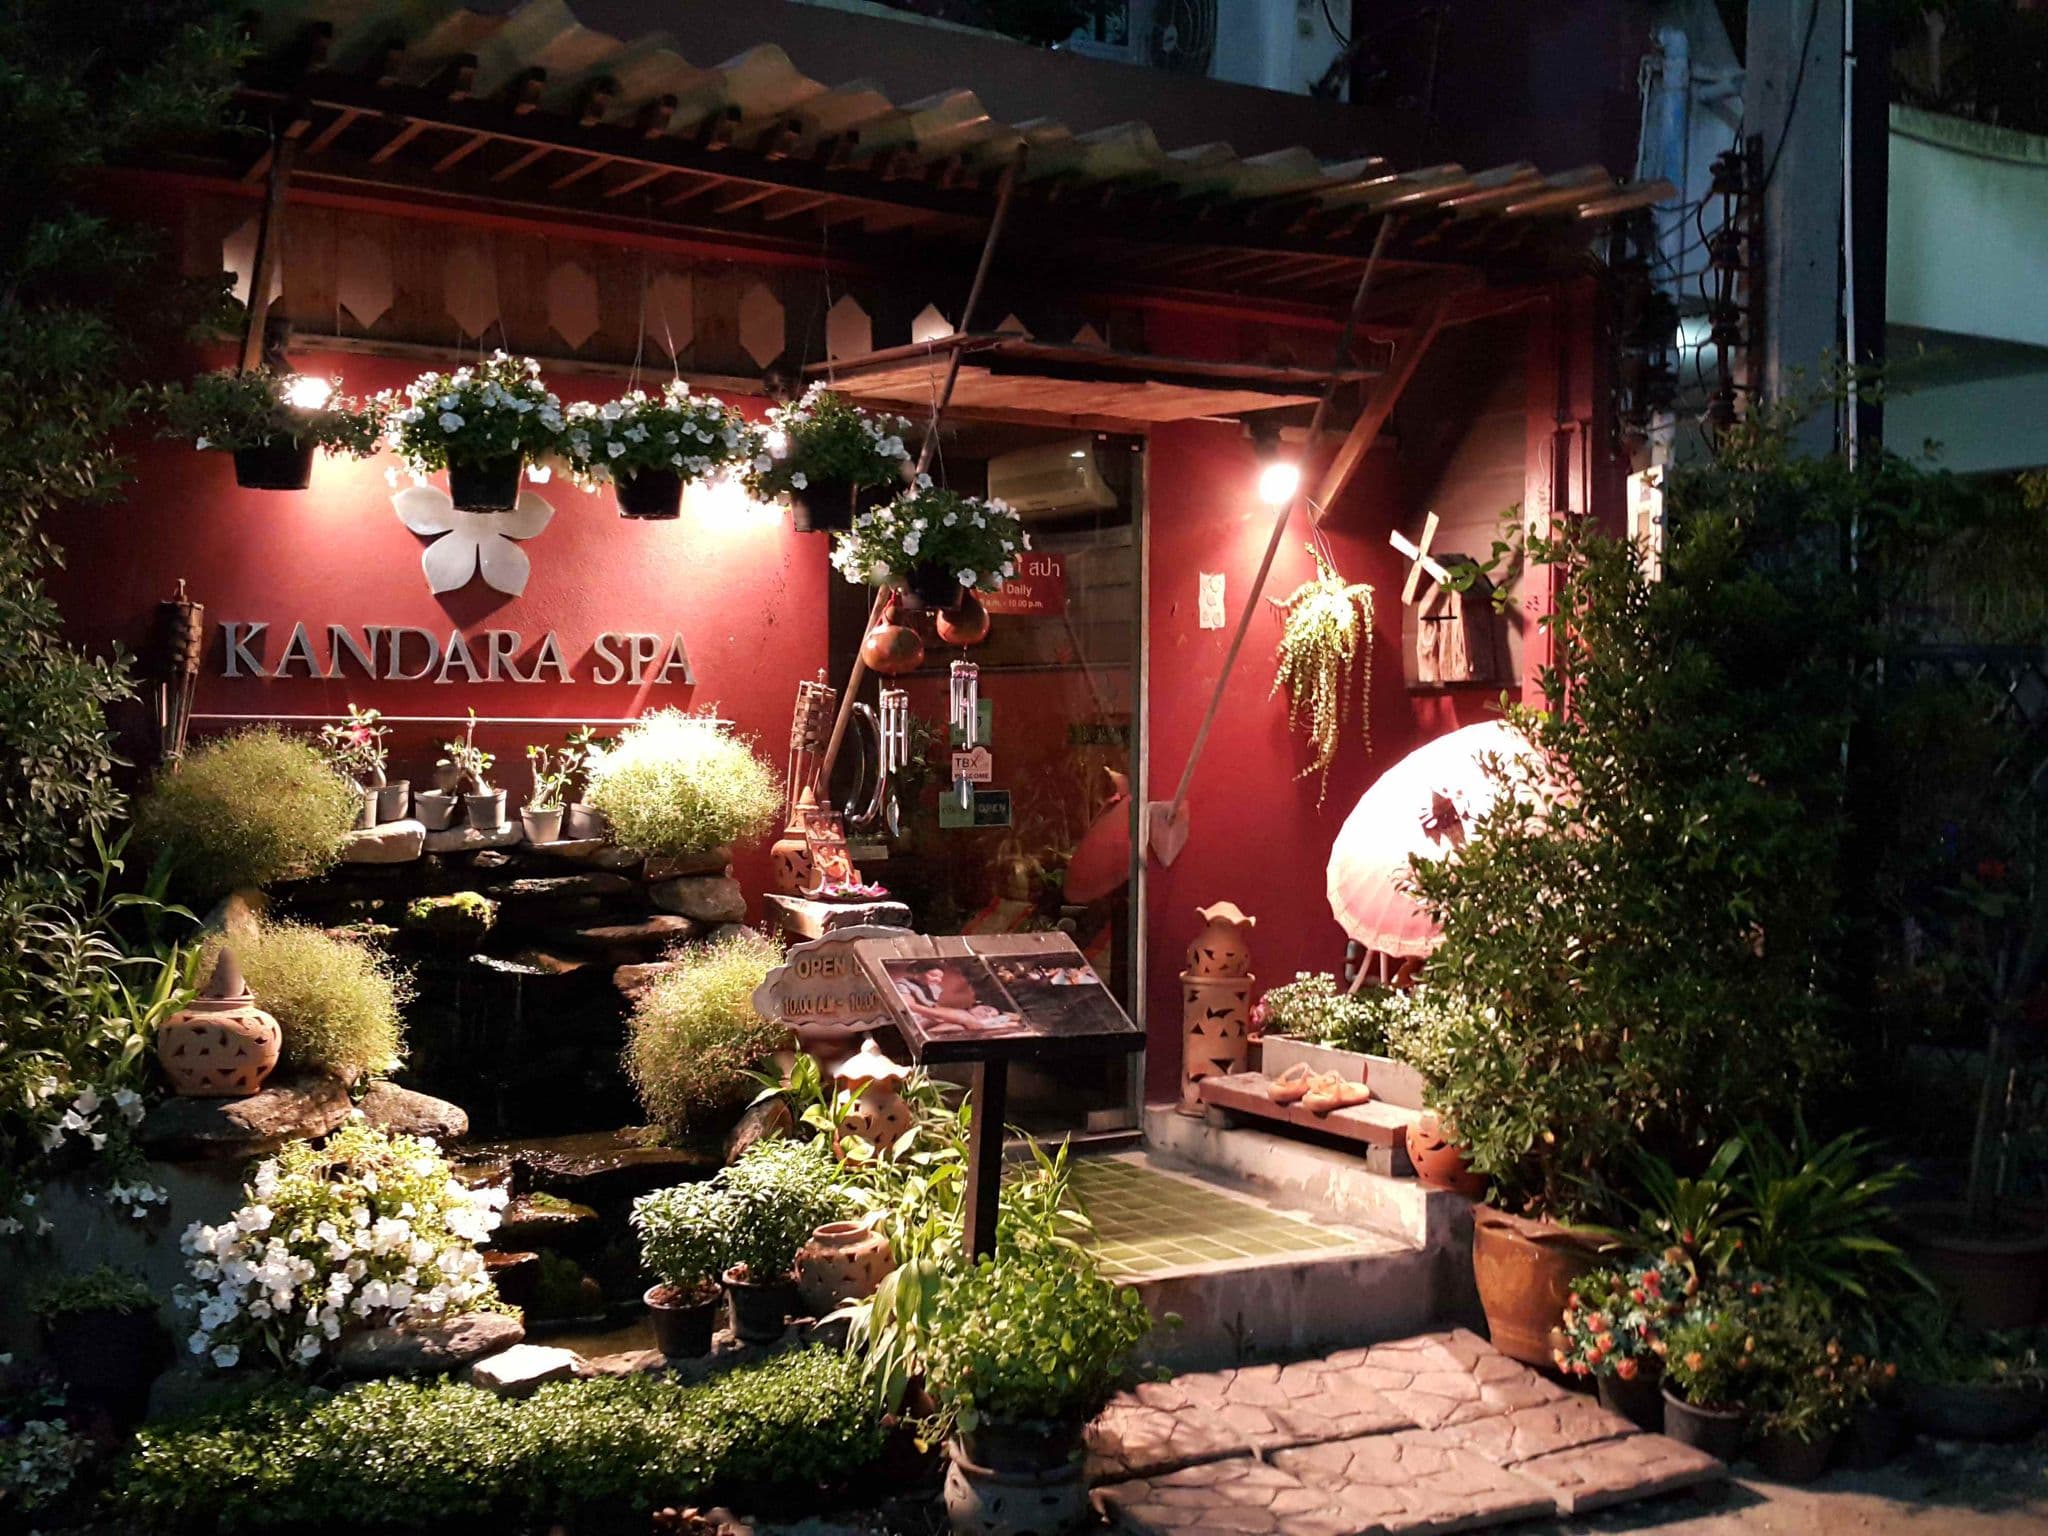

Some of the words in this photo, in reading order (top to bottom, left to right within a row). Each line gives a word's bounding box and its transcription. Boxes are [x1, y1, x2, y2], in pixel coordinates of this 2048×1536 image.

[1029, 556, 1060, 577] สปา
[1006, 584, 1032, 597] Daily
[219, 621, 576, 684] KANDARA
[593, 631, 697, 685] SPA
[796, 956, 845, 979] OPEN
[783, 995, 814, 1015] 10.00
